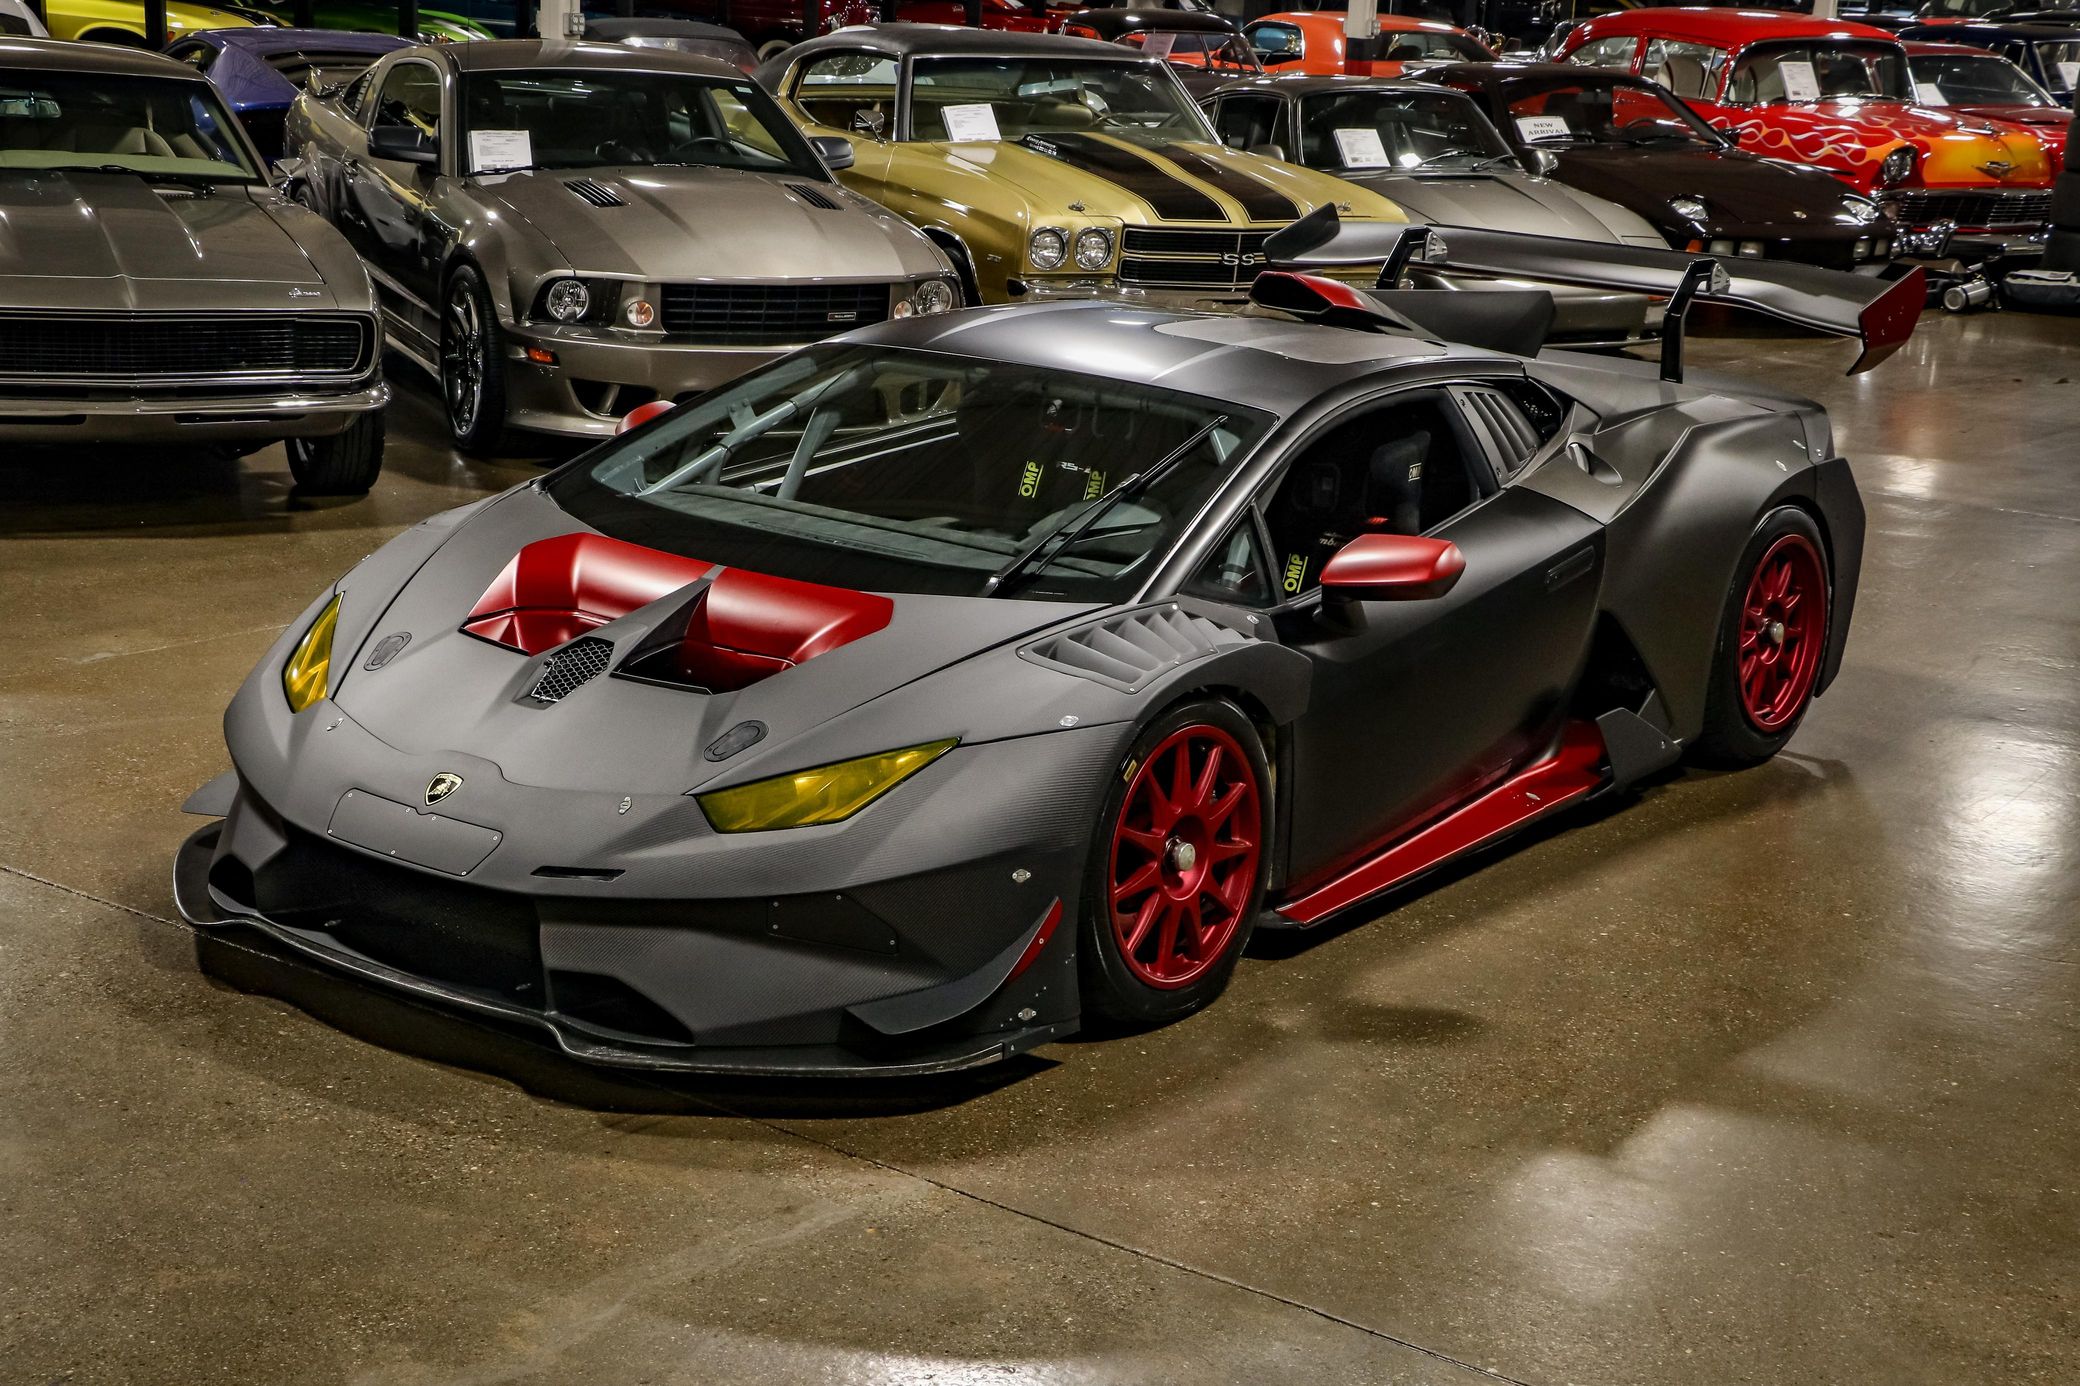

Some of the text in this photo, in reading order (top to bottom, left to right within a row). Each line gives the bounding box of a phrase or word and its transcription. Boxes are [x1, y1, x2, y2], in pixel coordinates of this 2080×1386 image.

[1222, 253, 1255, 266] SS
[1020, 461, 1039, 497] OMP
[1283, 553, 1304, 592] OMP
